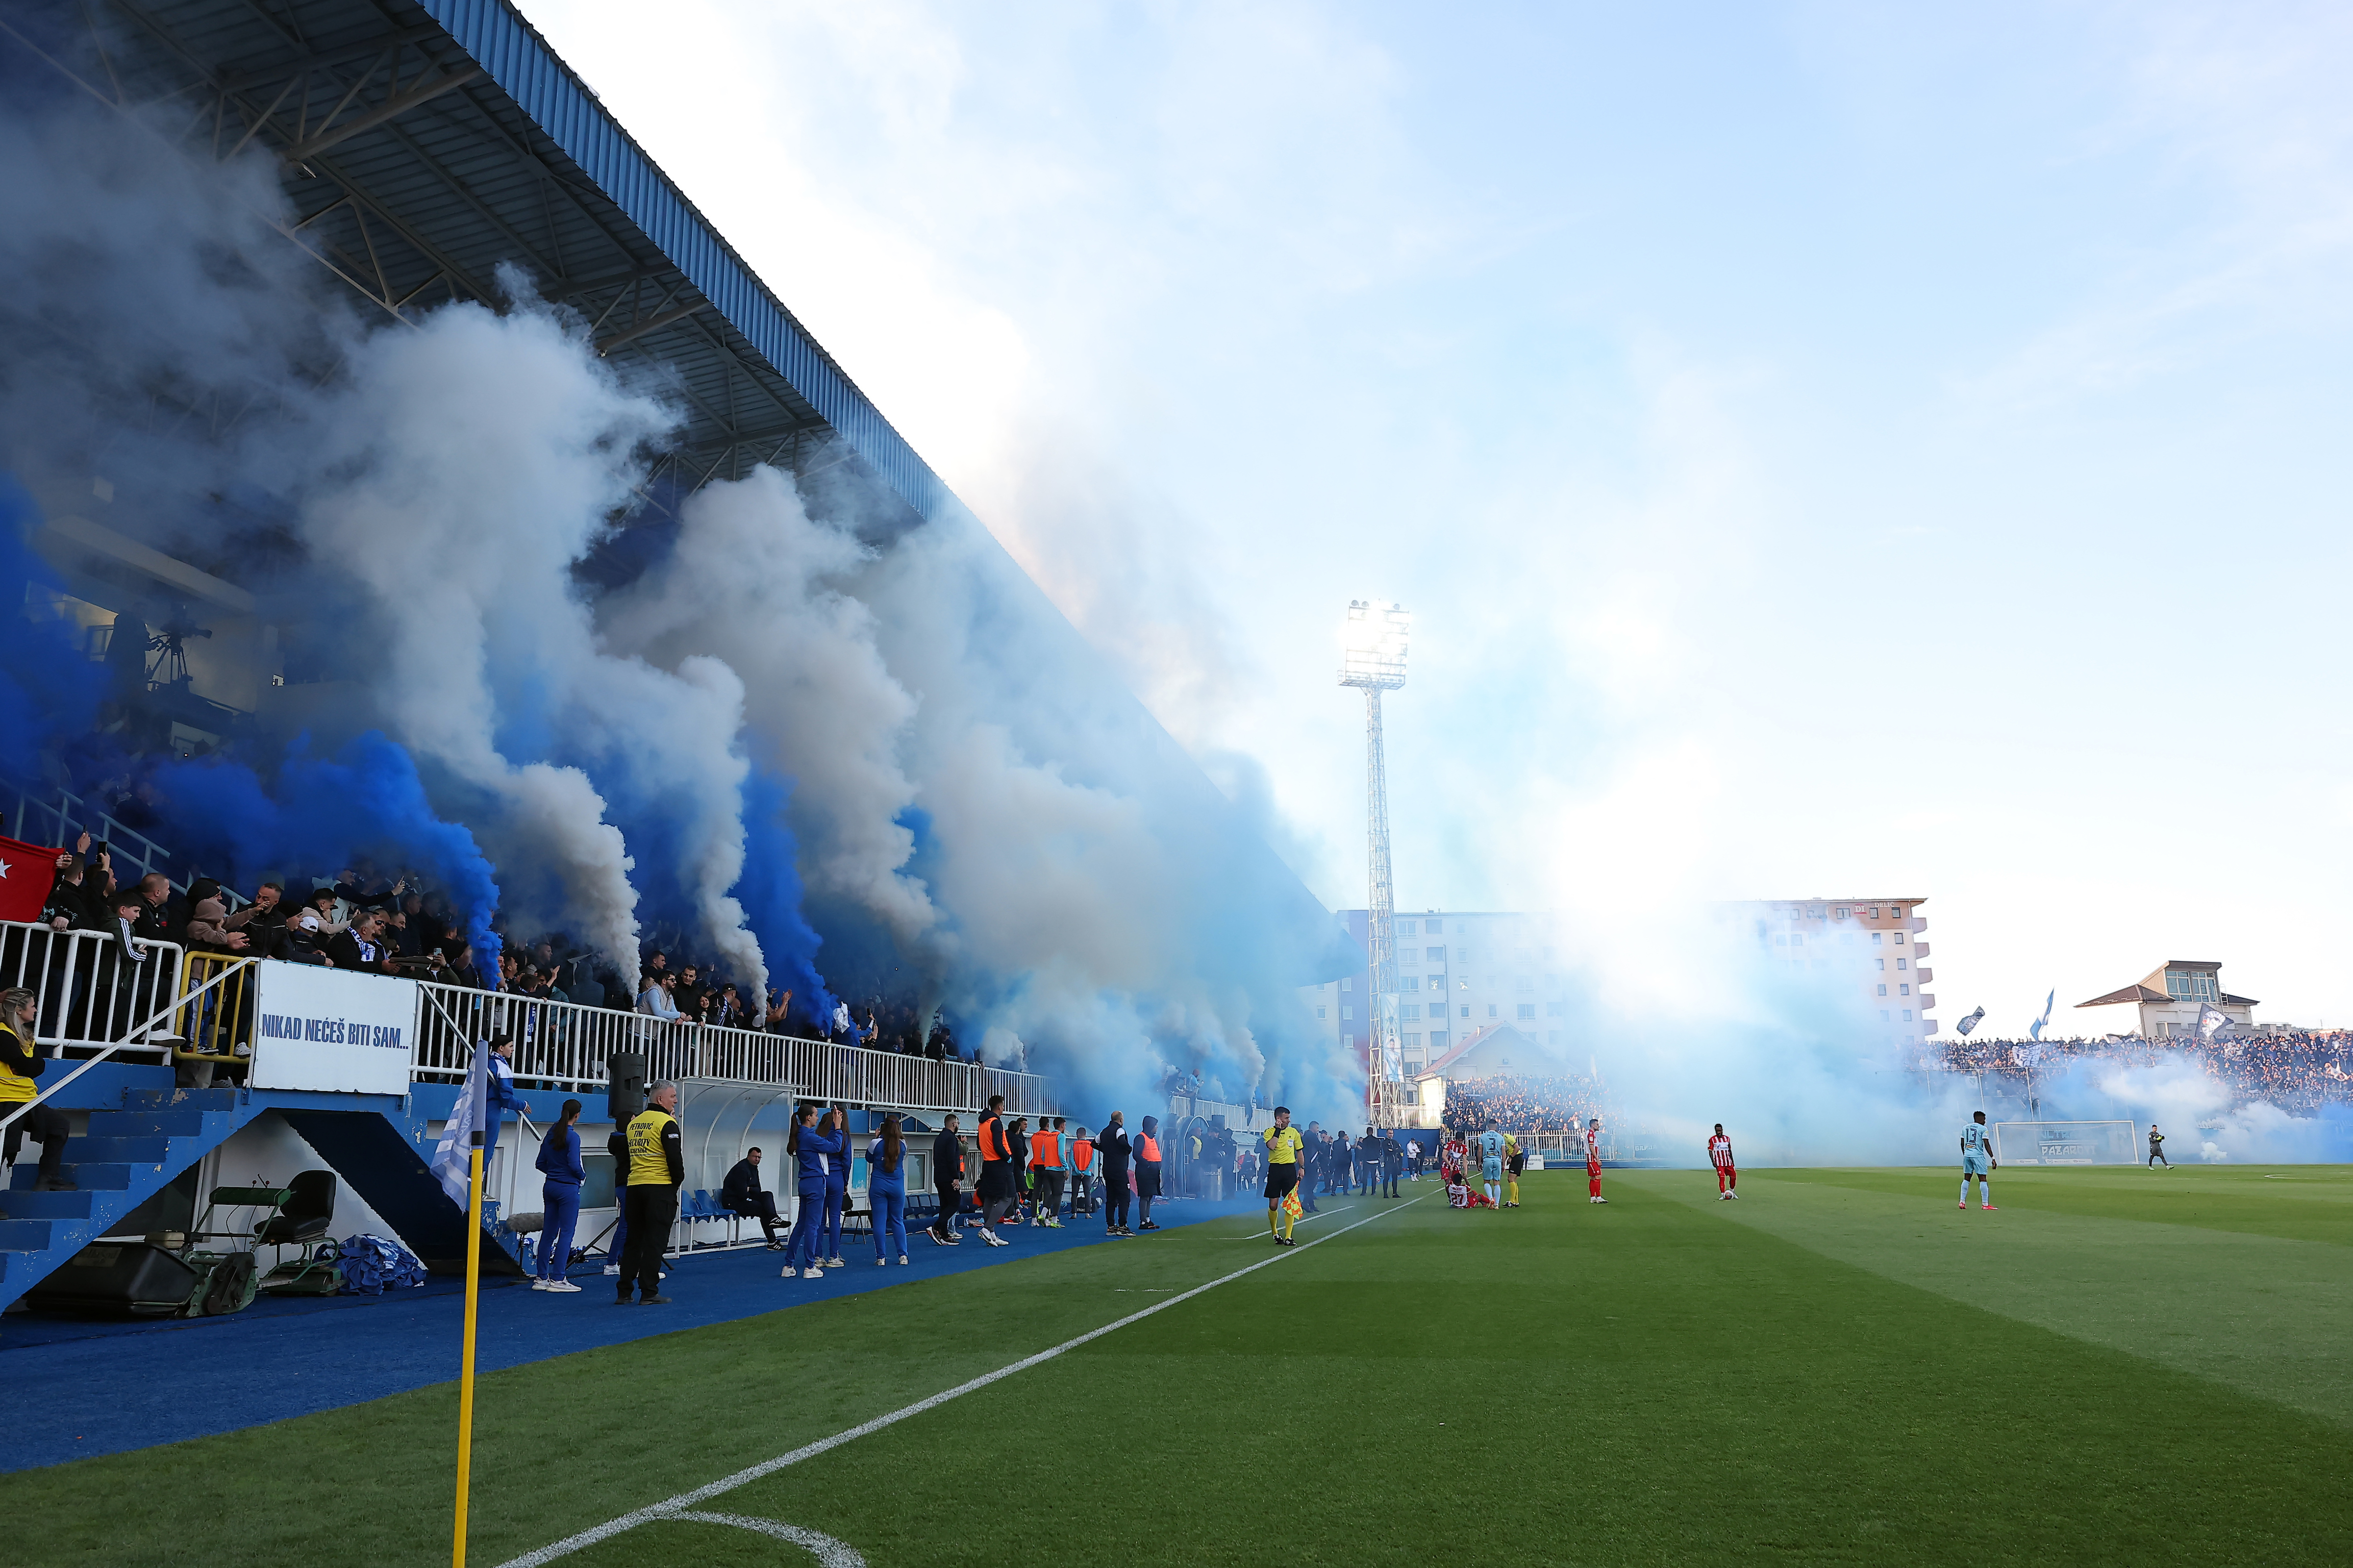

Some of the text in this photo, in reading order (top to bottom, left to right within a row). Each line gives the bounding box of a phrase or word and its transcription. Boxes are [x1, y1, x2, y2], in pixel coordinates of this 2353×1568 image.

[262, 1014, 408, 1049] NIKAD NEĆEŠ BITI SAM...
[629, 1121, 654, 1131] PETKOVIĆ
[1965, 1128, 1977, 1143] 13
[1489, 1138, 1496, 1150] 3
[1451, 1193, 1464, 1205] 27
